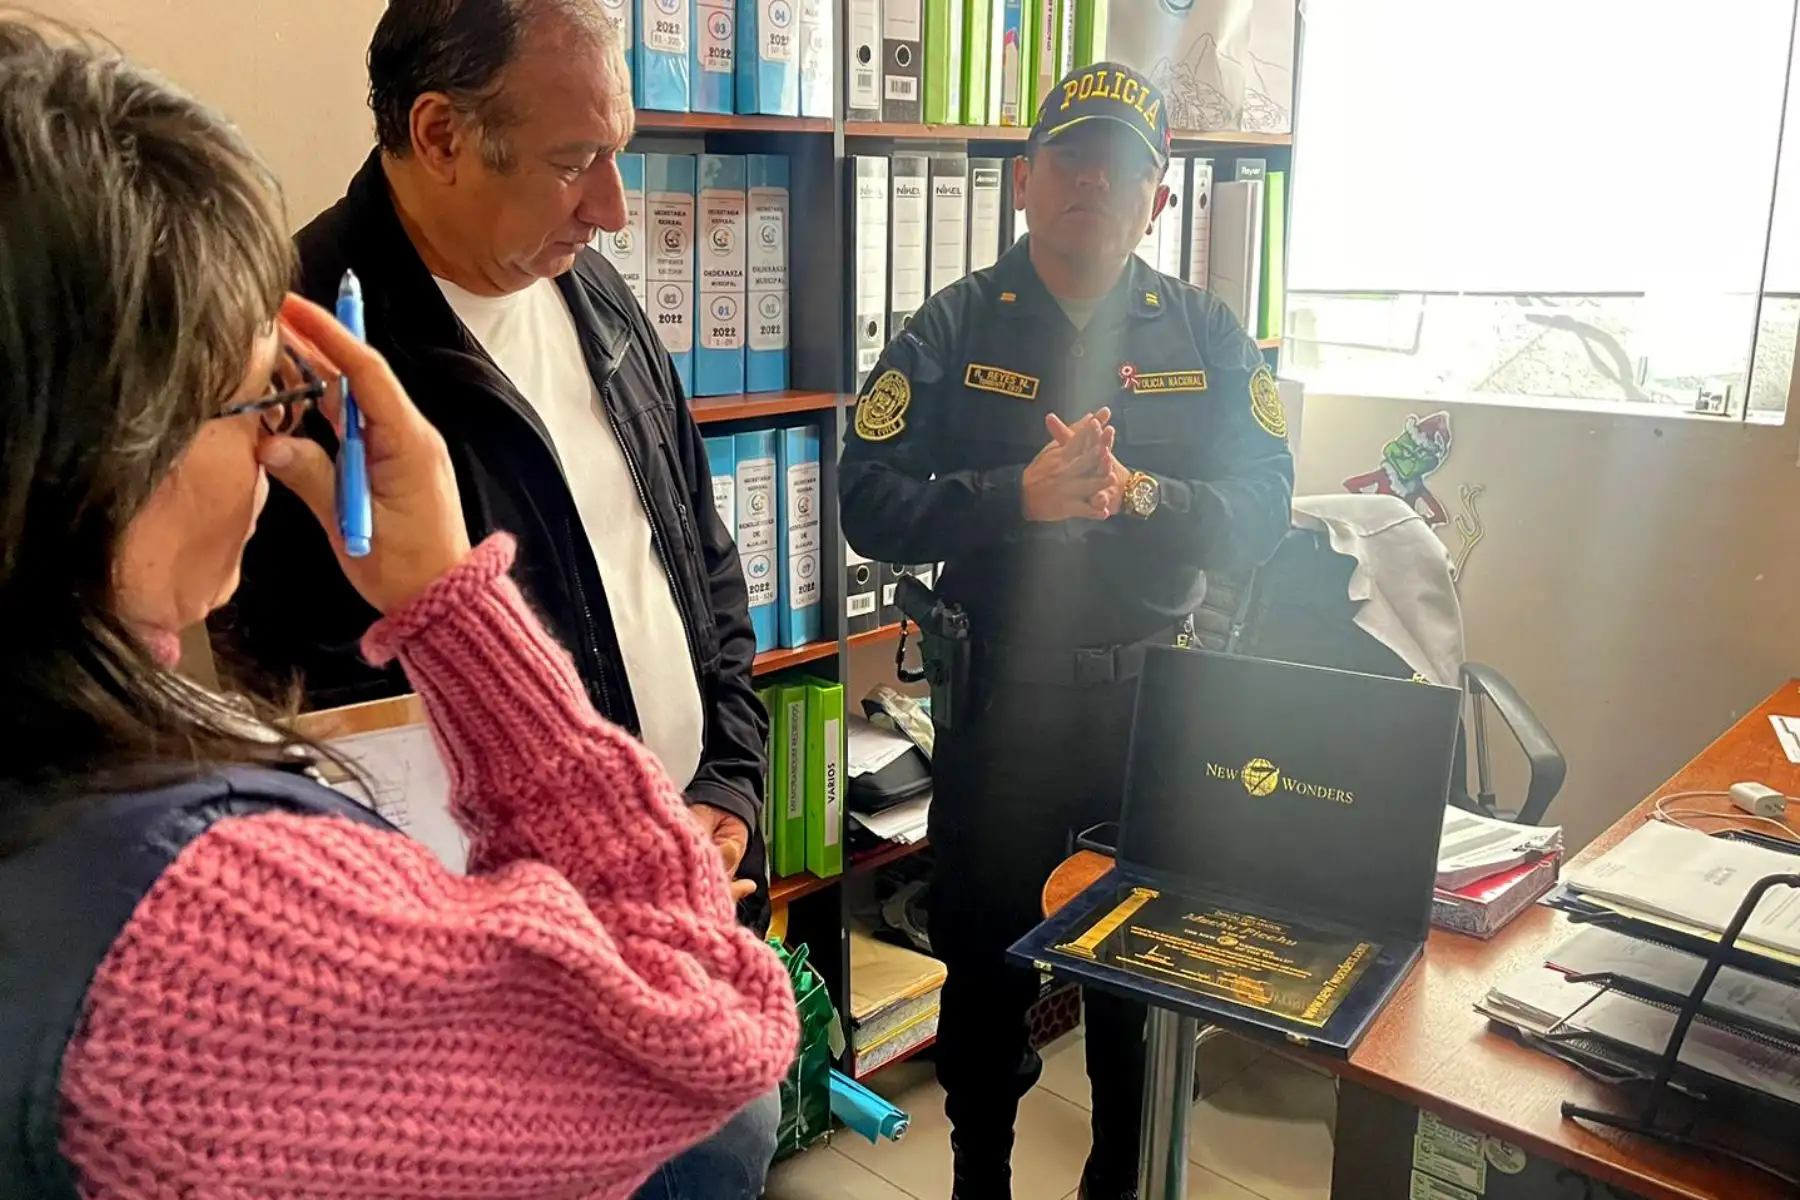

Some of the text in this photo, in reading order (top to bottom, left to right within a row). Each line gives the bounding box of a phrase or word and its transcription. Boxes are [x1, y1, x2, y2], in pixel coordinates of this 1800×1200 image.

[656, 20, 681, 34] 2022
[708, 47, 732, 59] 2022
[1060, 70, 1161, 131] POLICIA
[717, 305, 730, 316] 01
[658, 314, 683, 324] 2022
[712, 327, 737, 338] 2022
[760, 325, 781, 336] 2022
[1167, 375, 1202, 387] NACIONAL
[749, 582, 771, 594] 2022
[798, 581, 816, 595] 2022
[827, 762, 836, 805] VARIOS
[1205, 762, 1239, 780] NEW
[1281, 777, 1355, 805] WONDERS
